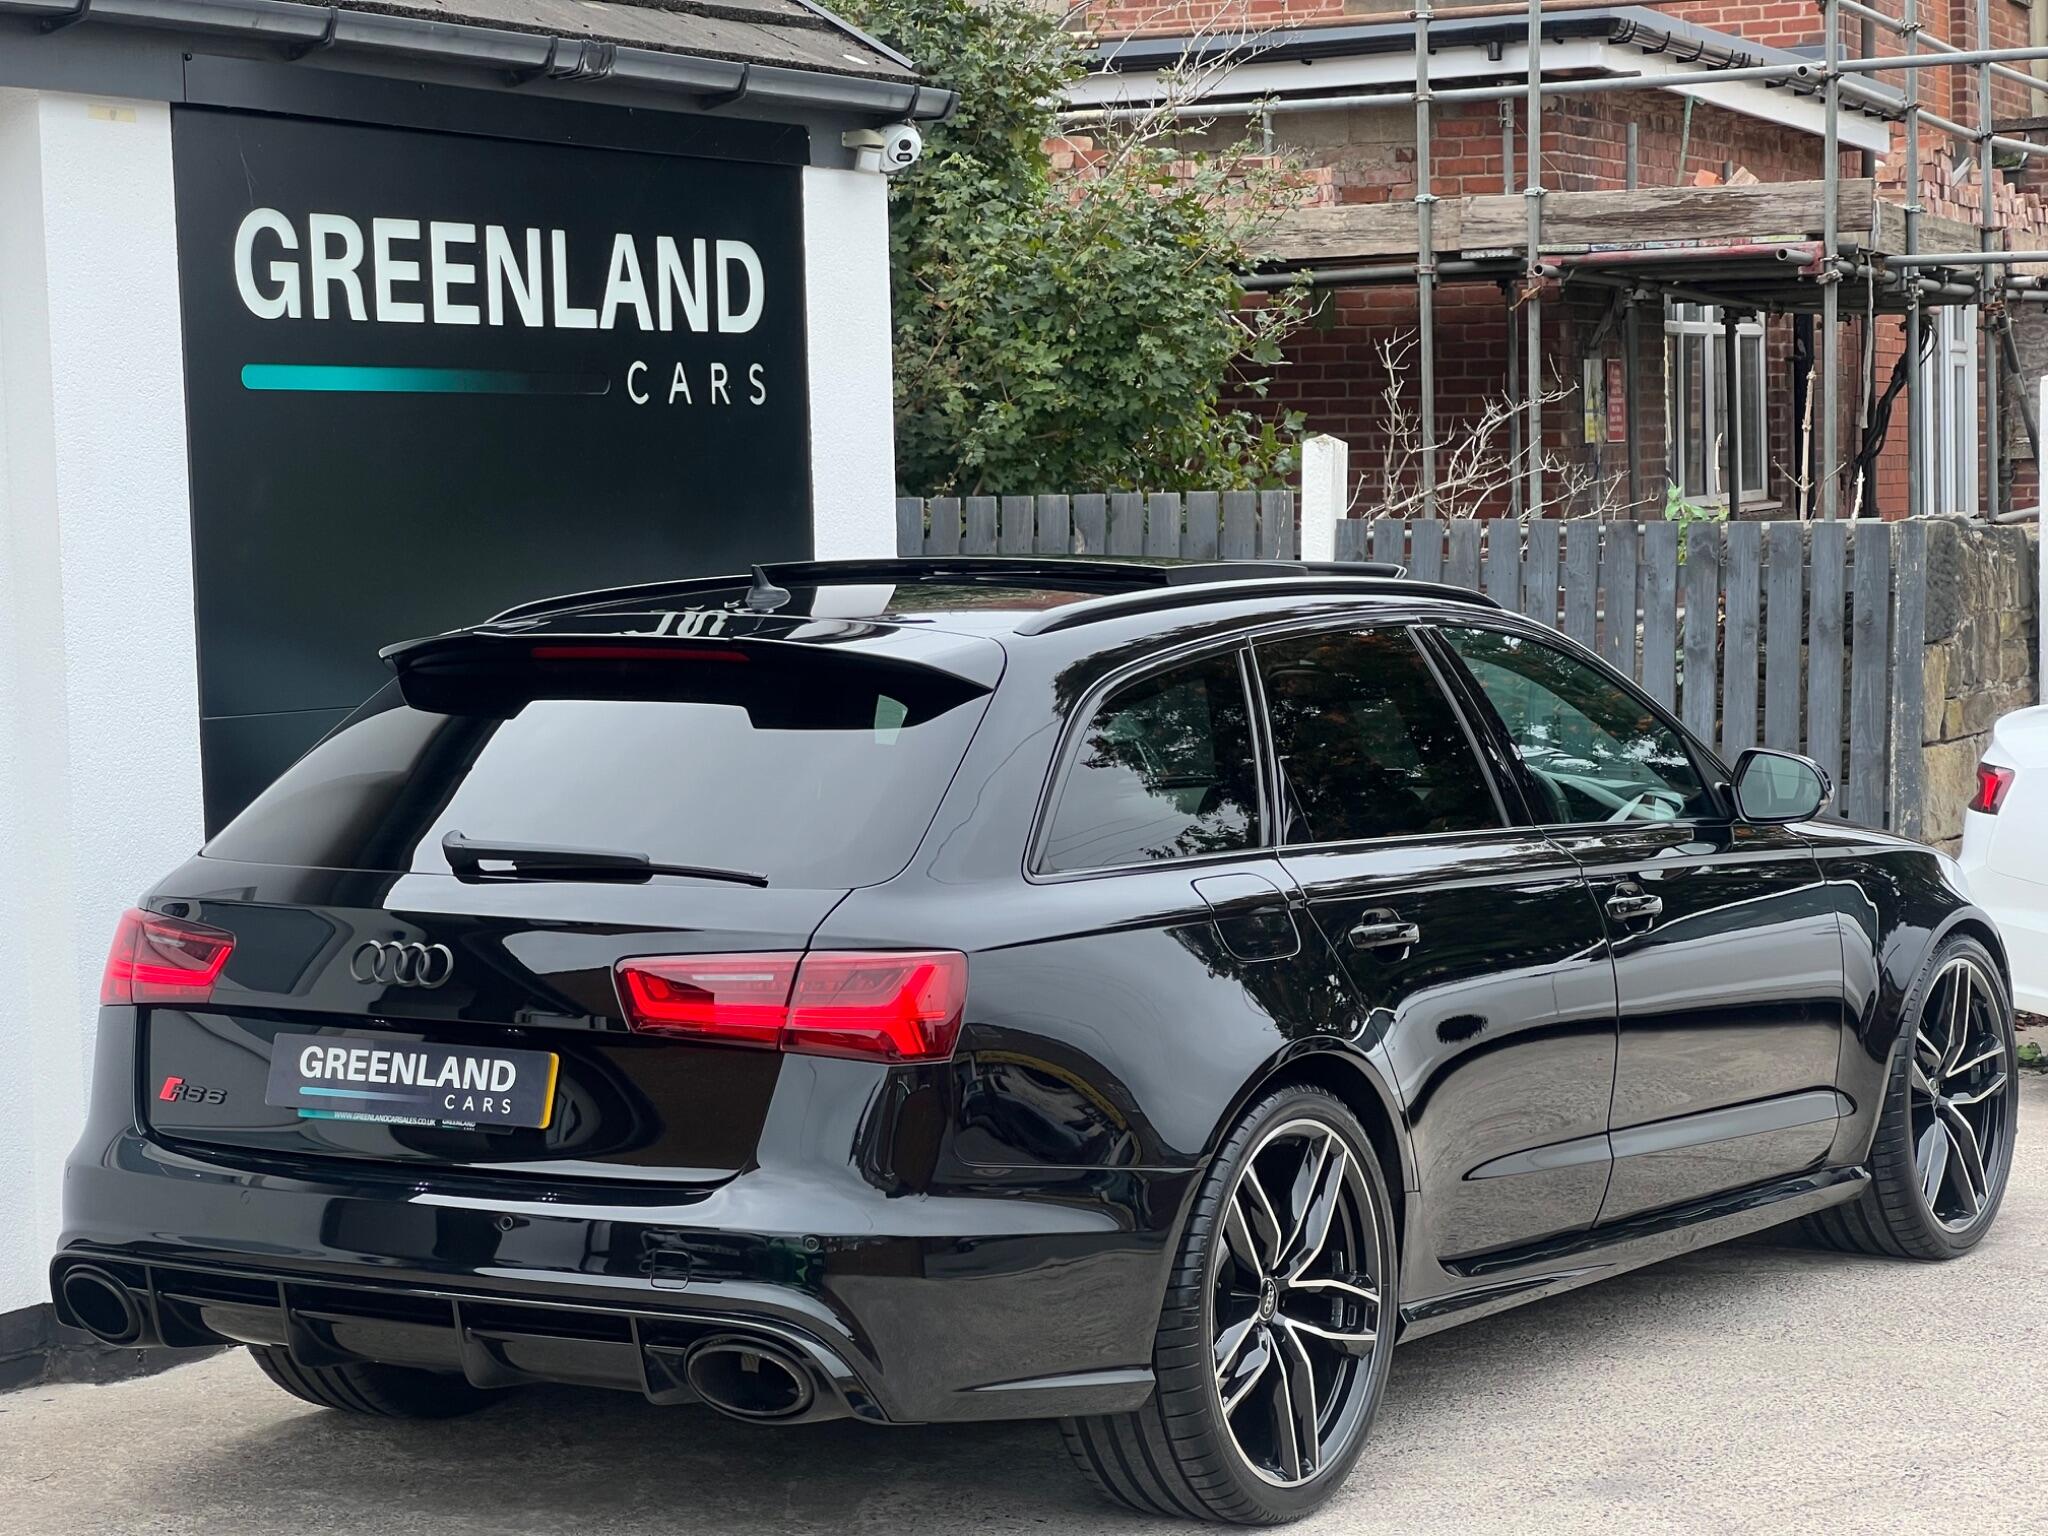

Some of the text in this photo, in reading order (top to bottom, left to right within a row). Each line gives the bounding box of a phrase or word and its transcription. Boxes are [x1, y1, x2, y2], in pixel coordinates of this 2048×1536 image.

[234, 207, 765, 333] GREENLAND
[626, 361, 767, 406] CARS
[159, 1074, 228, 1105] RS6
[299, 1045, 517, 1093] GREENLAND
[444, 1094, 512, 1115] CARS
